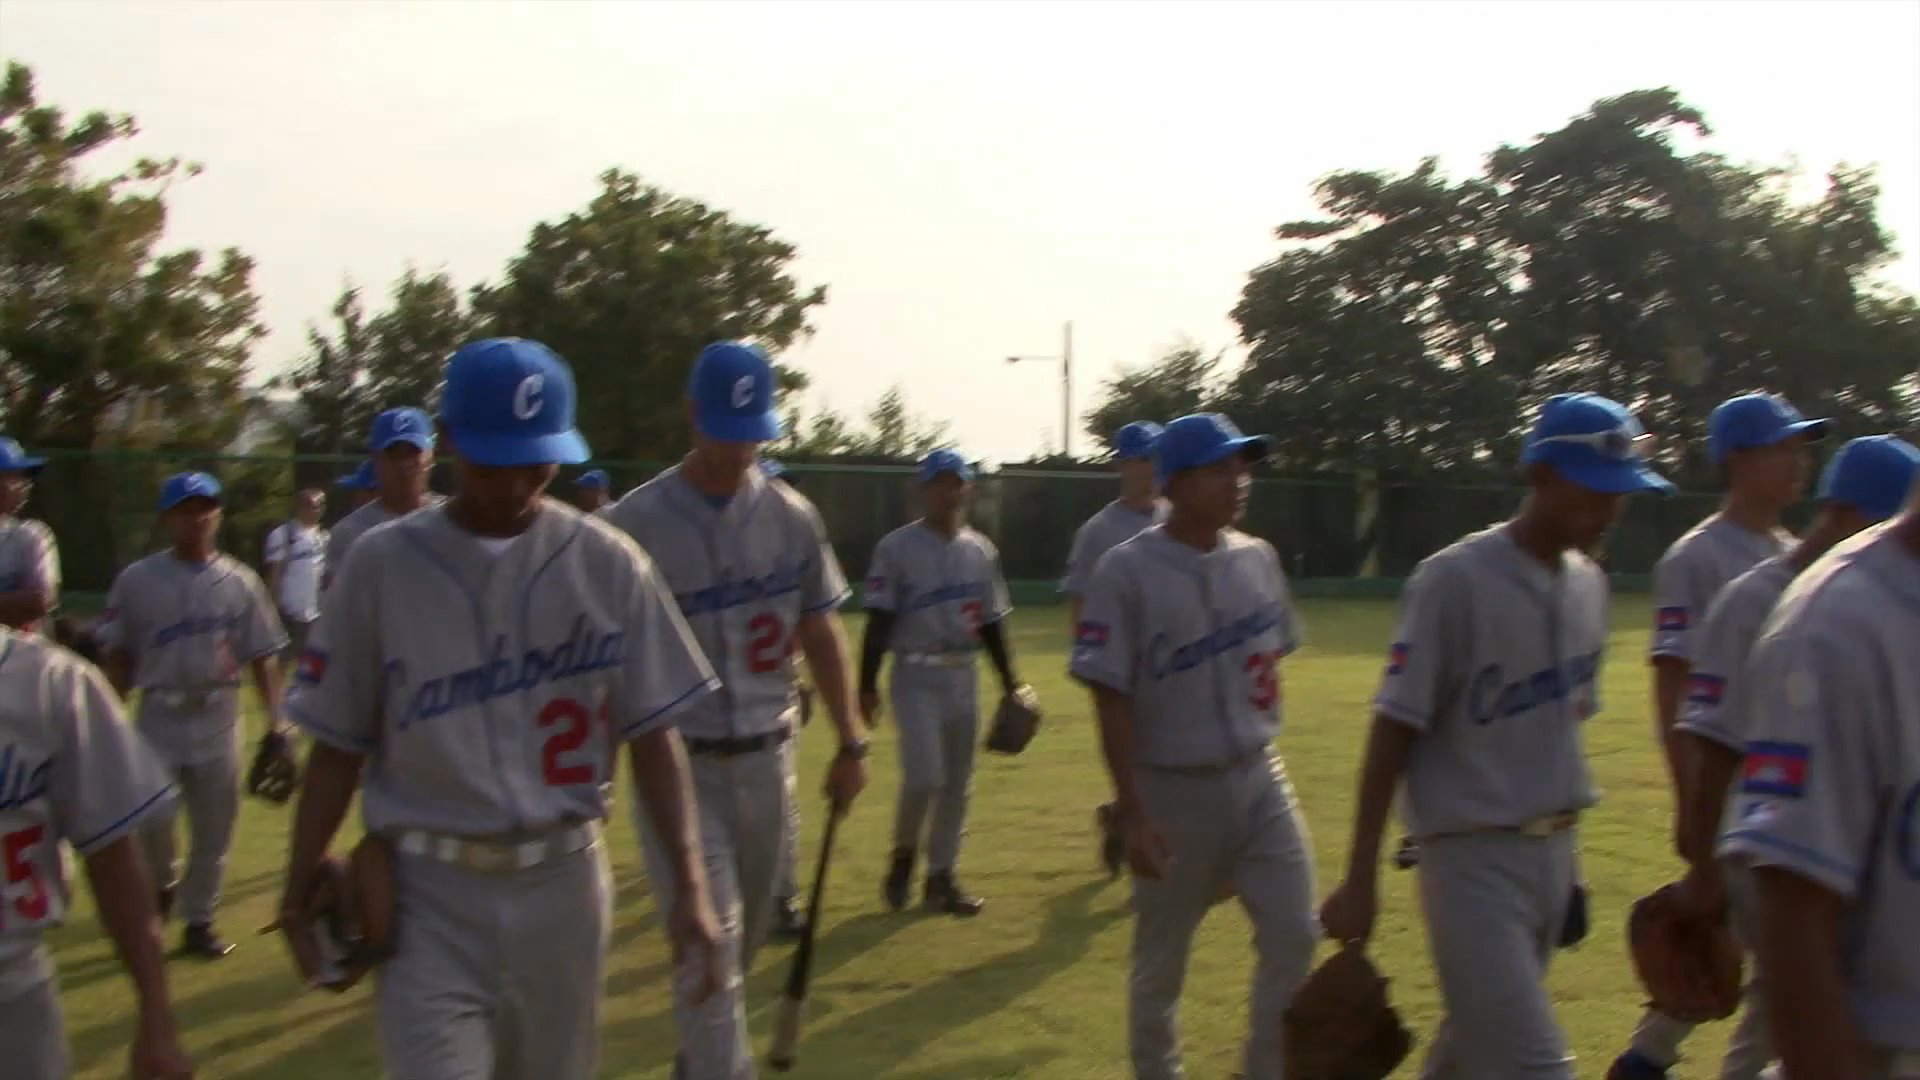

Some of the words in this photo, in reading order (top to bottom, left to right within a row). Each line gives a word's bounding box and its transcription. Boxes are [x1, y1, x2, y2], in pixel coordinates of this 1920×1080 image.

[513, 373, 544, 420] C
[732, 375, 755, 408] C
[385, 612, 626, 730] Cambodia
